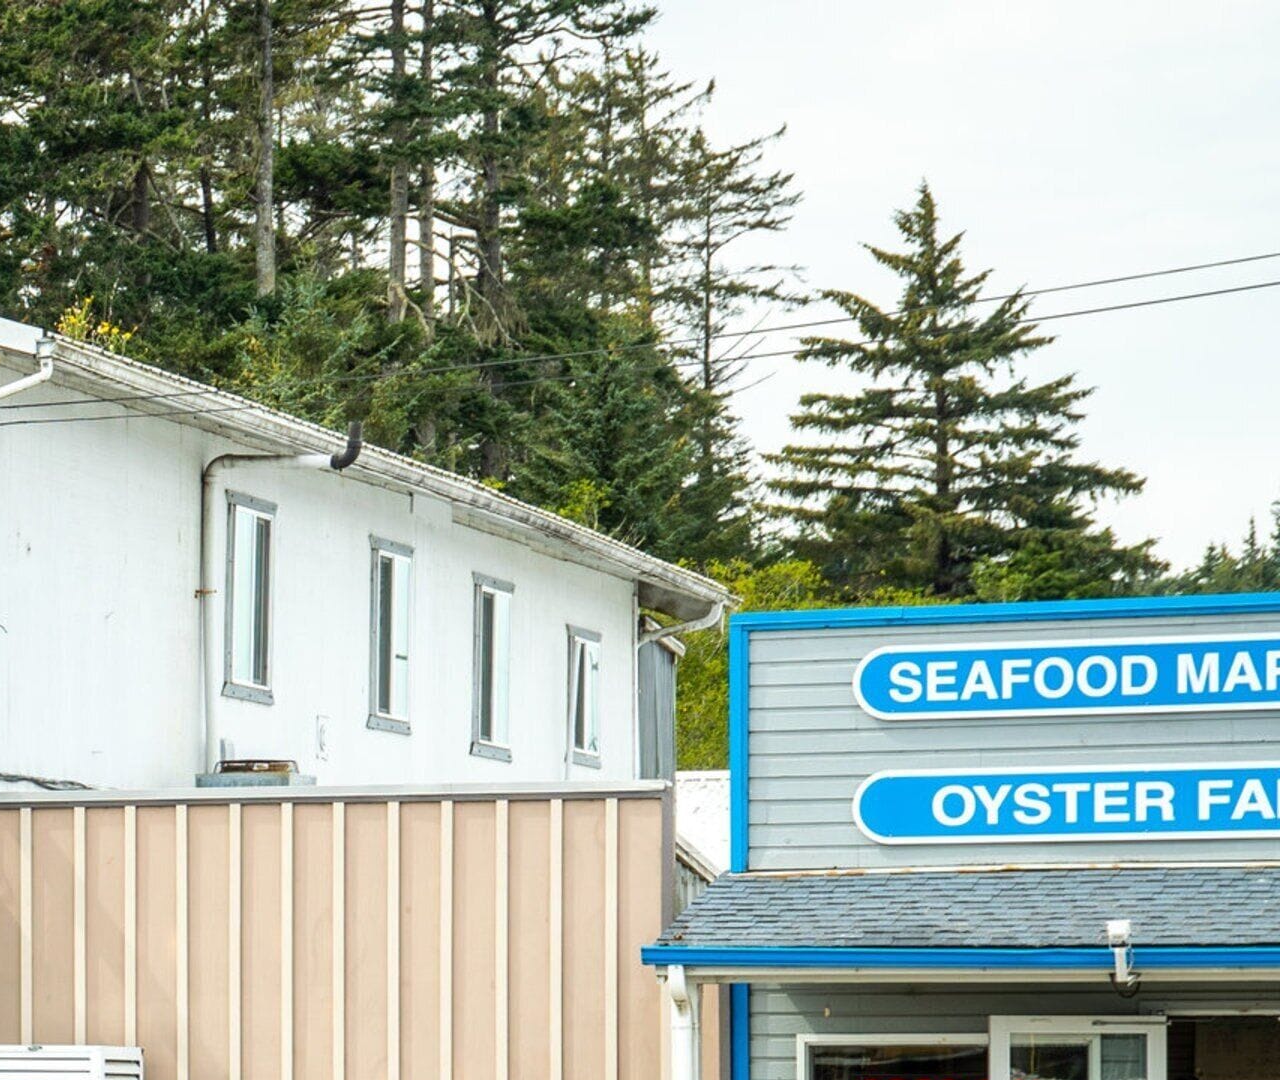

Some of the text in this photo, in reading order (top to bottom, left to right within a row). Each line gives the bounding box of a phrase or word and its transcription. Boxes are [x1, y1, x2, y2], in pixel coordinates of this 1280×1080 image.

[889, 654, 1158, 703] SEAFOOD
[932, 778, 1280, 827] OYSTER FA
